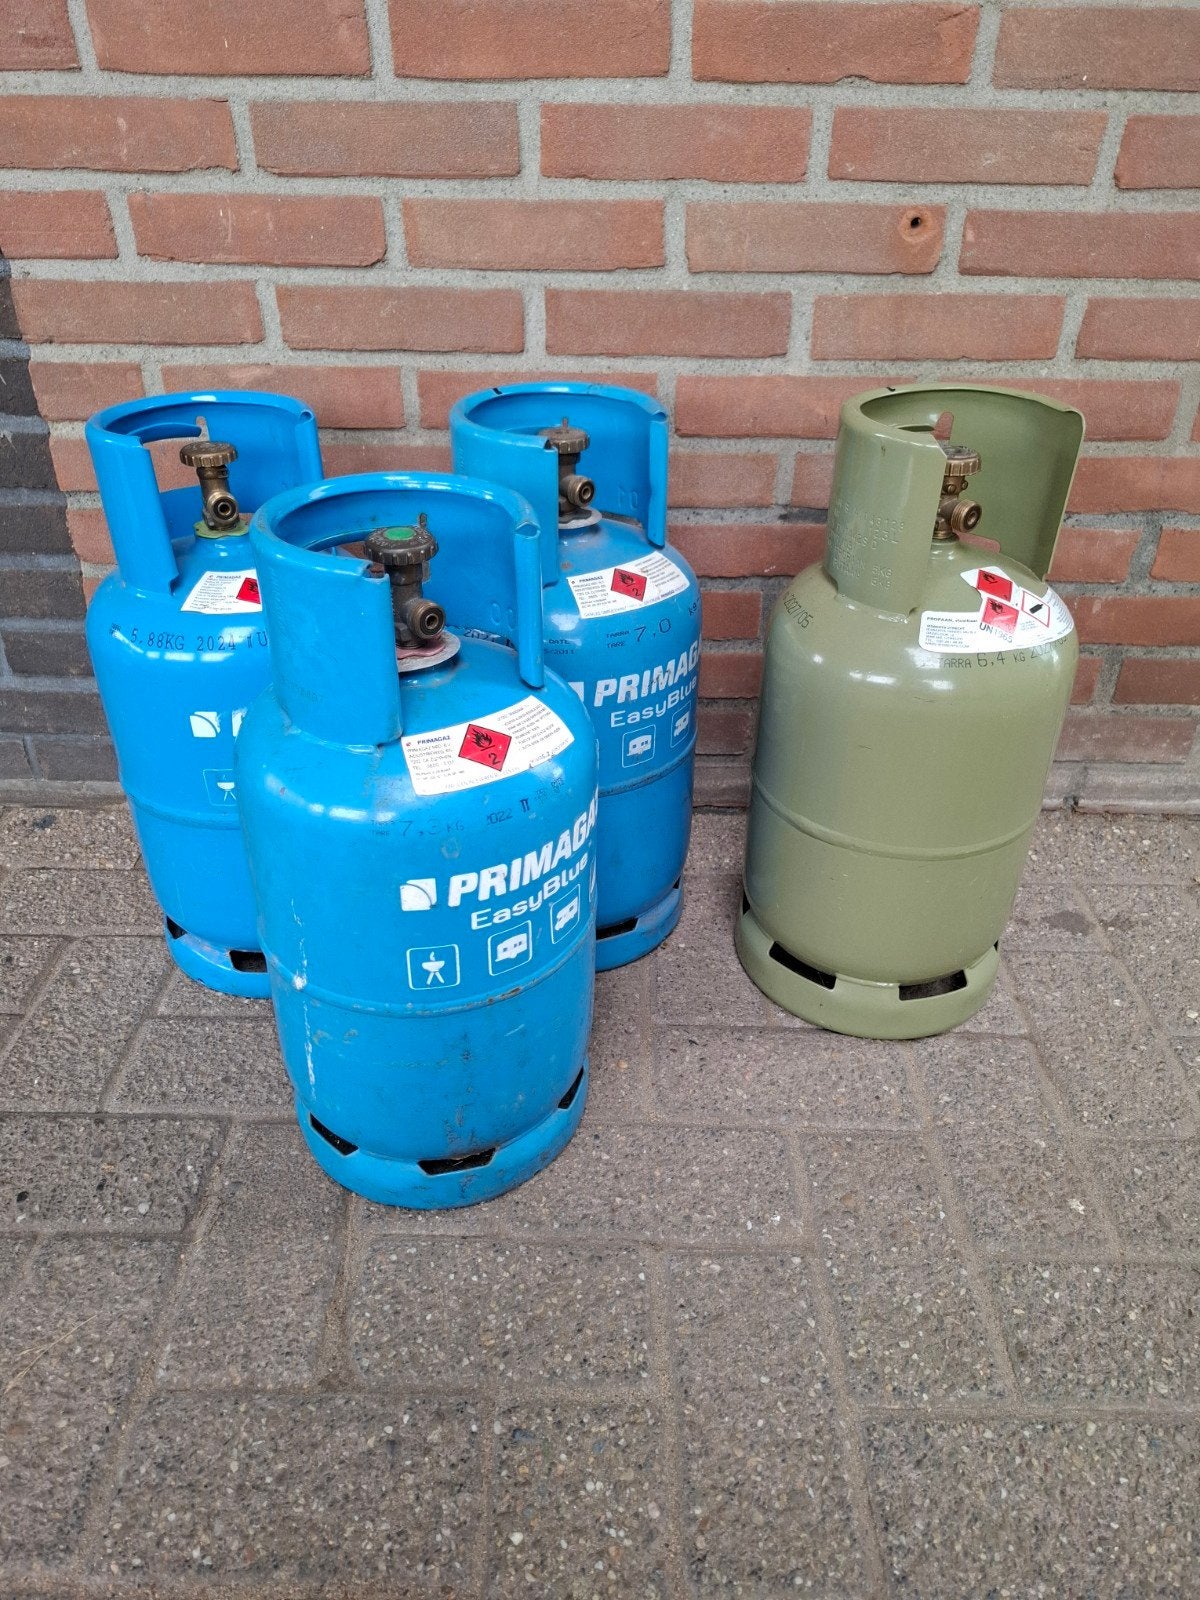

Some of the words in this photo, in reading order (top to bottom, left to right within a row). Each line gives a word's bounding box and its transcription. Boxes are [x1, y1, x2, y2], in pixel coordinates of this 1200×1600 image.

[632, 588, 641, 596] 2
[593, 640, 700, 708] PRIMAG
[1013, 652, 1026, 662] KG
[610, 675, 697, 728] EasyBlue
[488, 752, 500, 765] 2
[447, 783, 599, 908] PRIMAGA
[470, 852, 589, 931] EasyBlue
